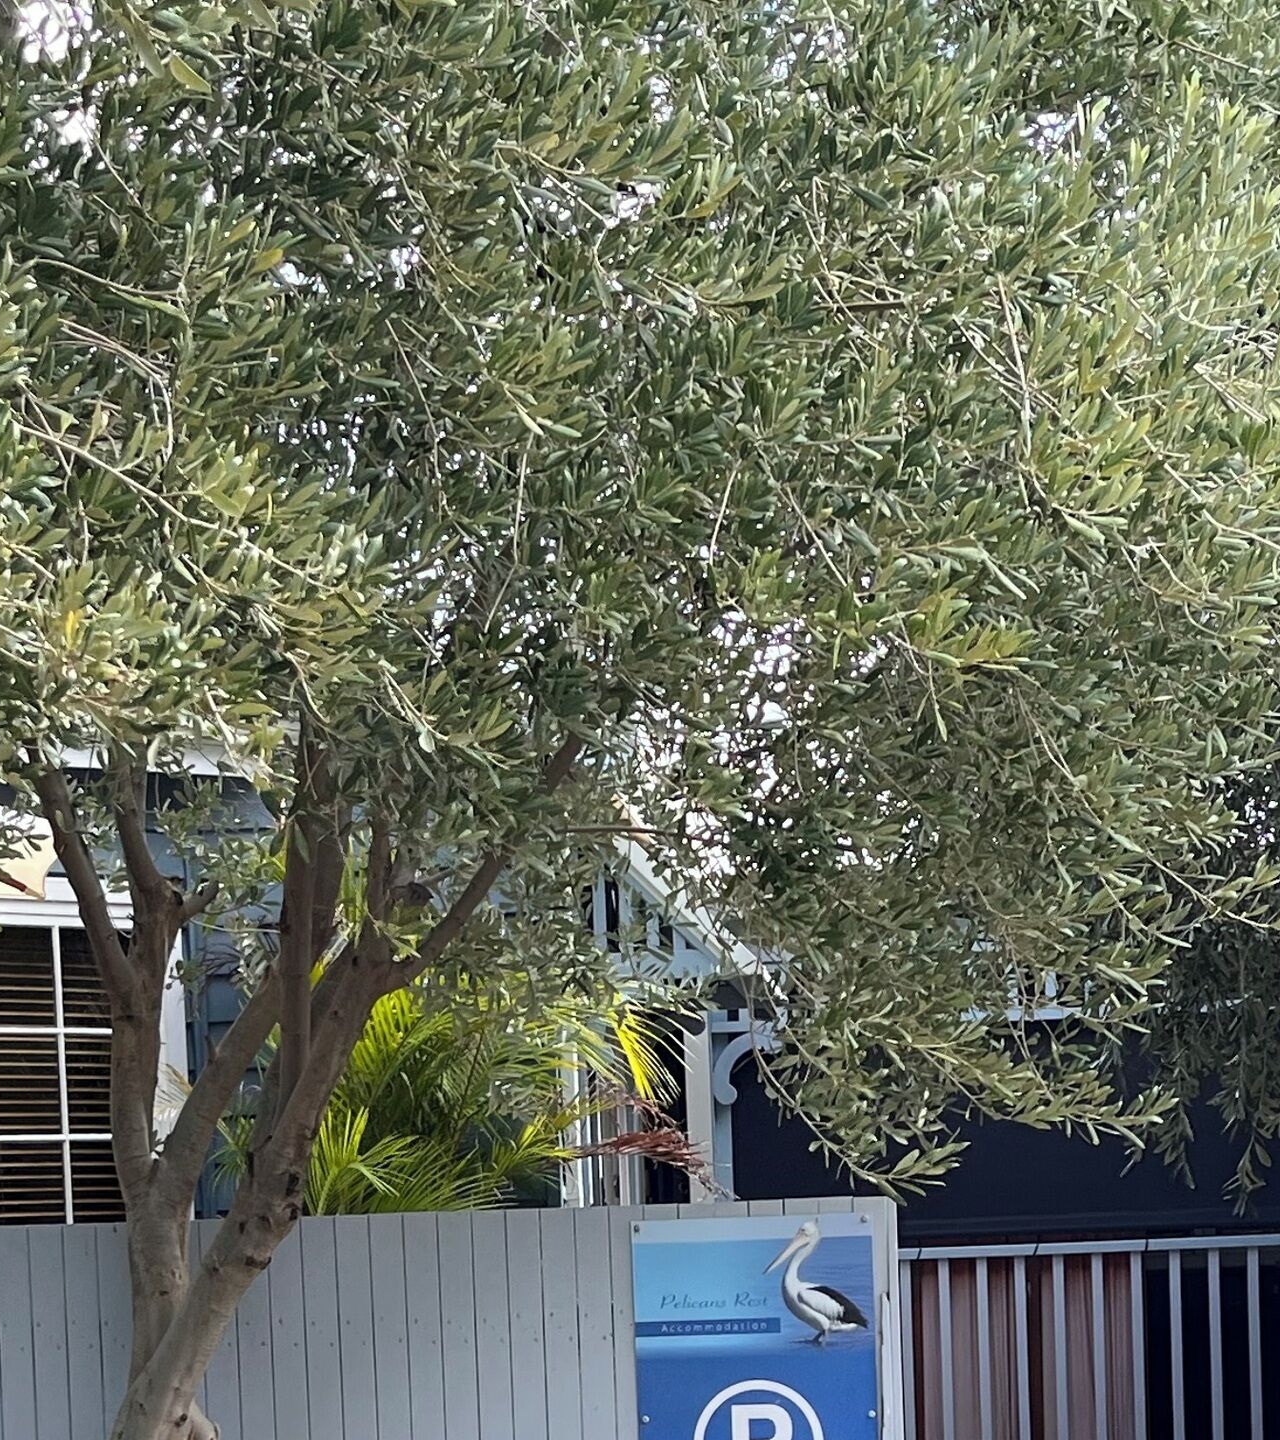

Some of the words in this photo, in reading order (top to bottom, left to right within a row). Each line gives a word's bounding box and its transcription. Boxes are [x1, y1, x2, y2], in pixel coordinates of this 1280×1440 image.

[660, 1293, 727, 1310] Pelicans
[734, 1291, 769, 1309] Rest
[660, 1320, 767, 1333] Accommodation
